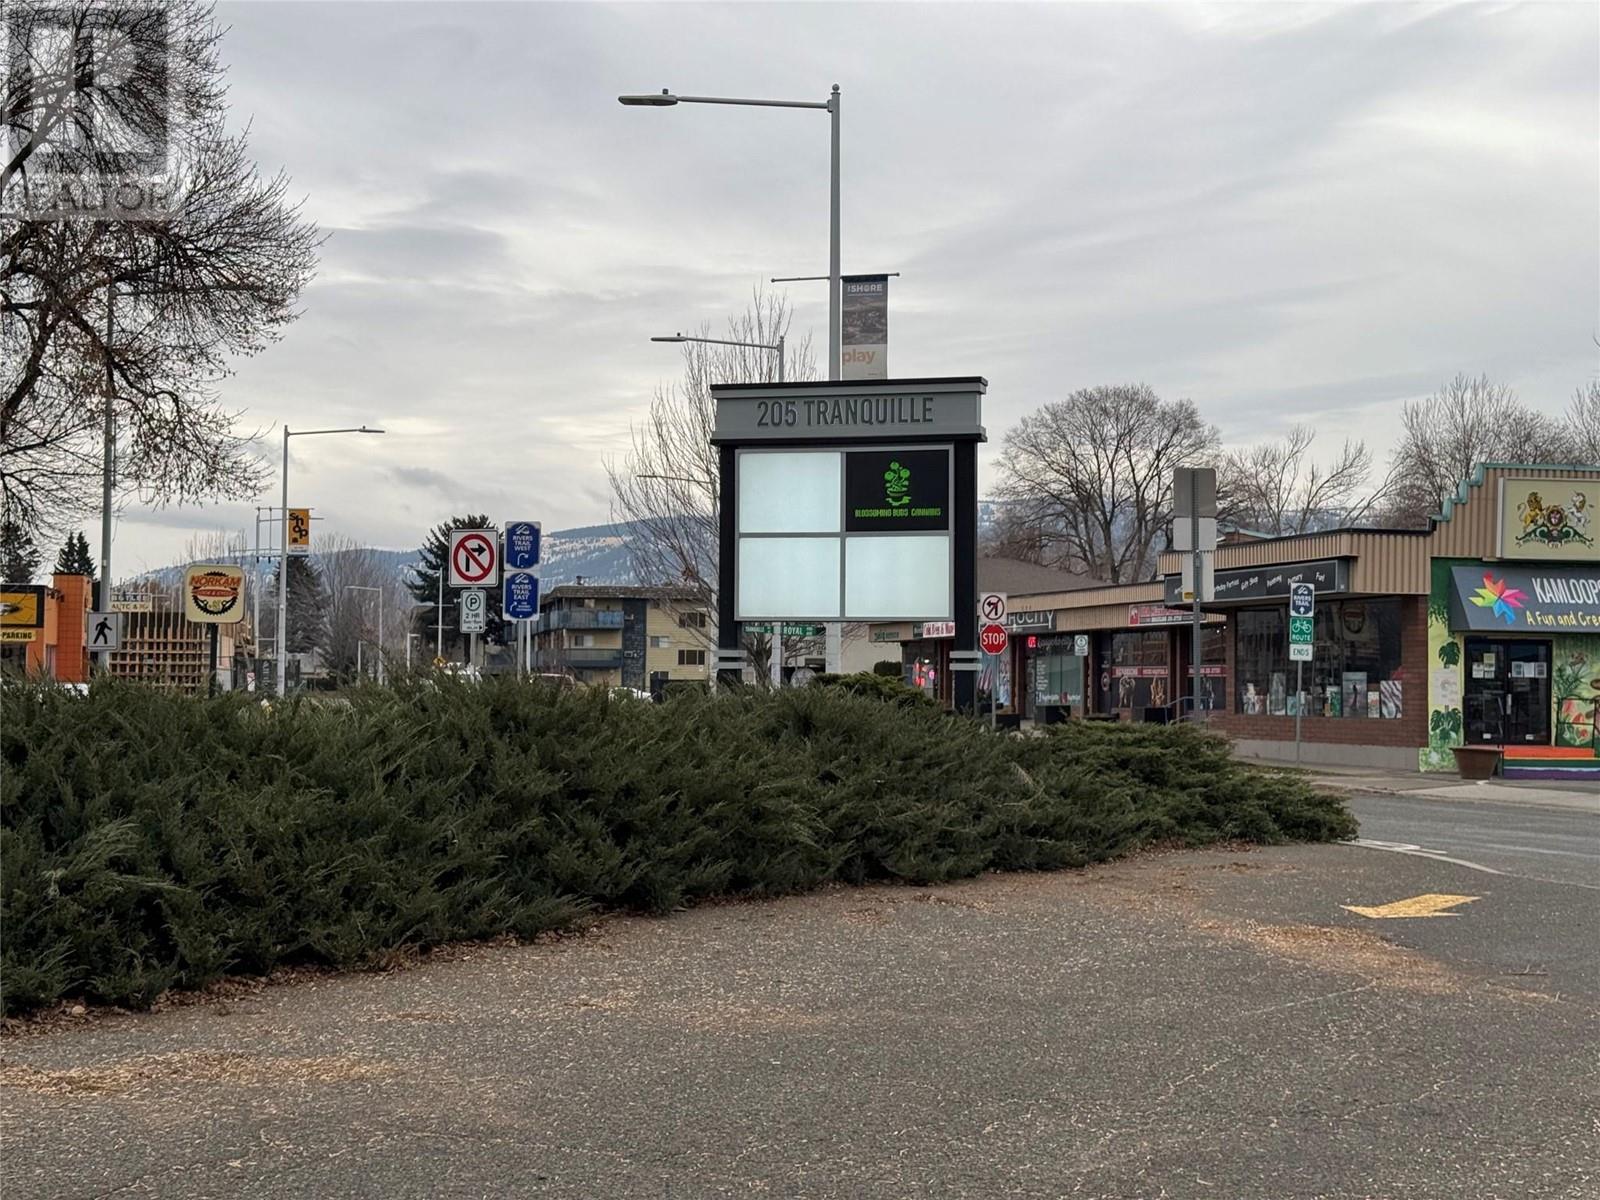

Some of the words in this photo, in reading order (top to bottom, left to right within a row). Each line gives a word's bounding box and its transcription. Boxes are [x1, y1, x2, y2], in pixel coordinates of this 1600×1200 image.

[842, 348, 876, 366] play
[757, 400, 797, 427] 205
[803, 397, 934, 426] TRANQUILLE
[189, 575, 242, 587] NORKAM
[470, 597, 478, 608] P
[1526, 610, 1536, 625] A
[1535, 610, 1556, 626] Fun
[1557, 610, 1576, 626] and
[2, 631, 33, 640] PARKING
[783, 626, 803, 635] ROYAL
[982, 632, 1006, 645] STOP
[1293, 648, 1310, 657] ENDS
